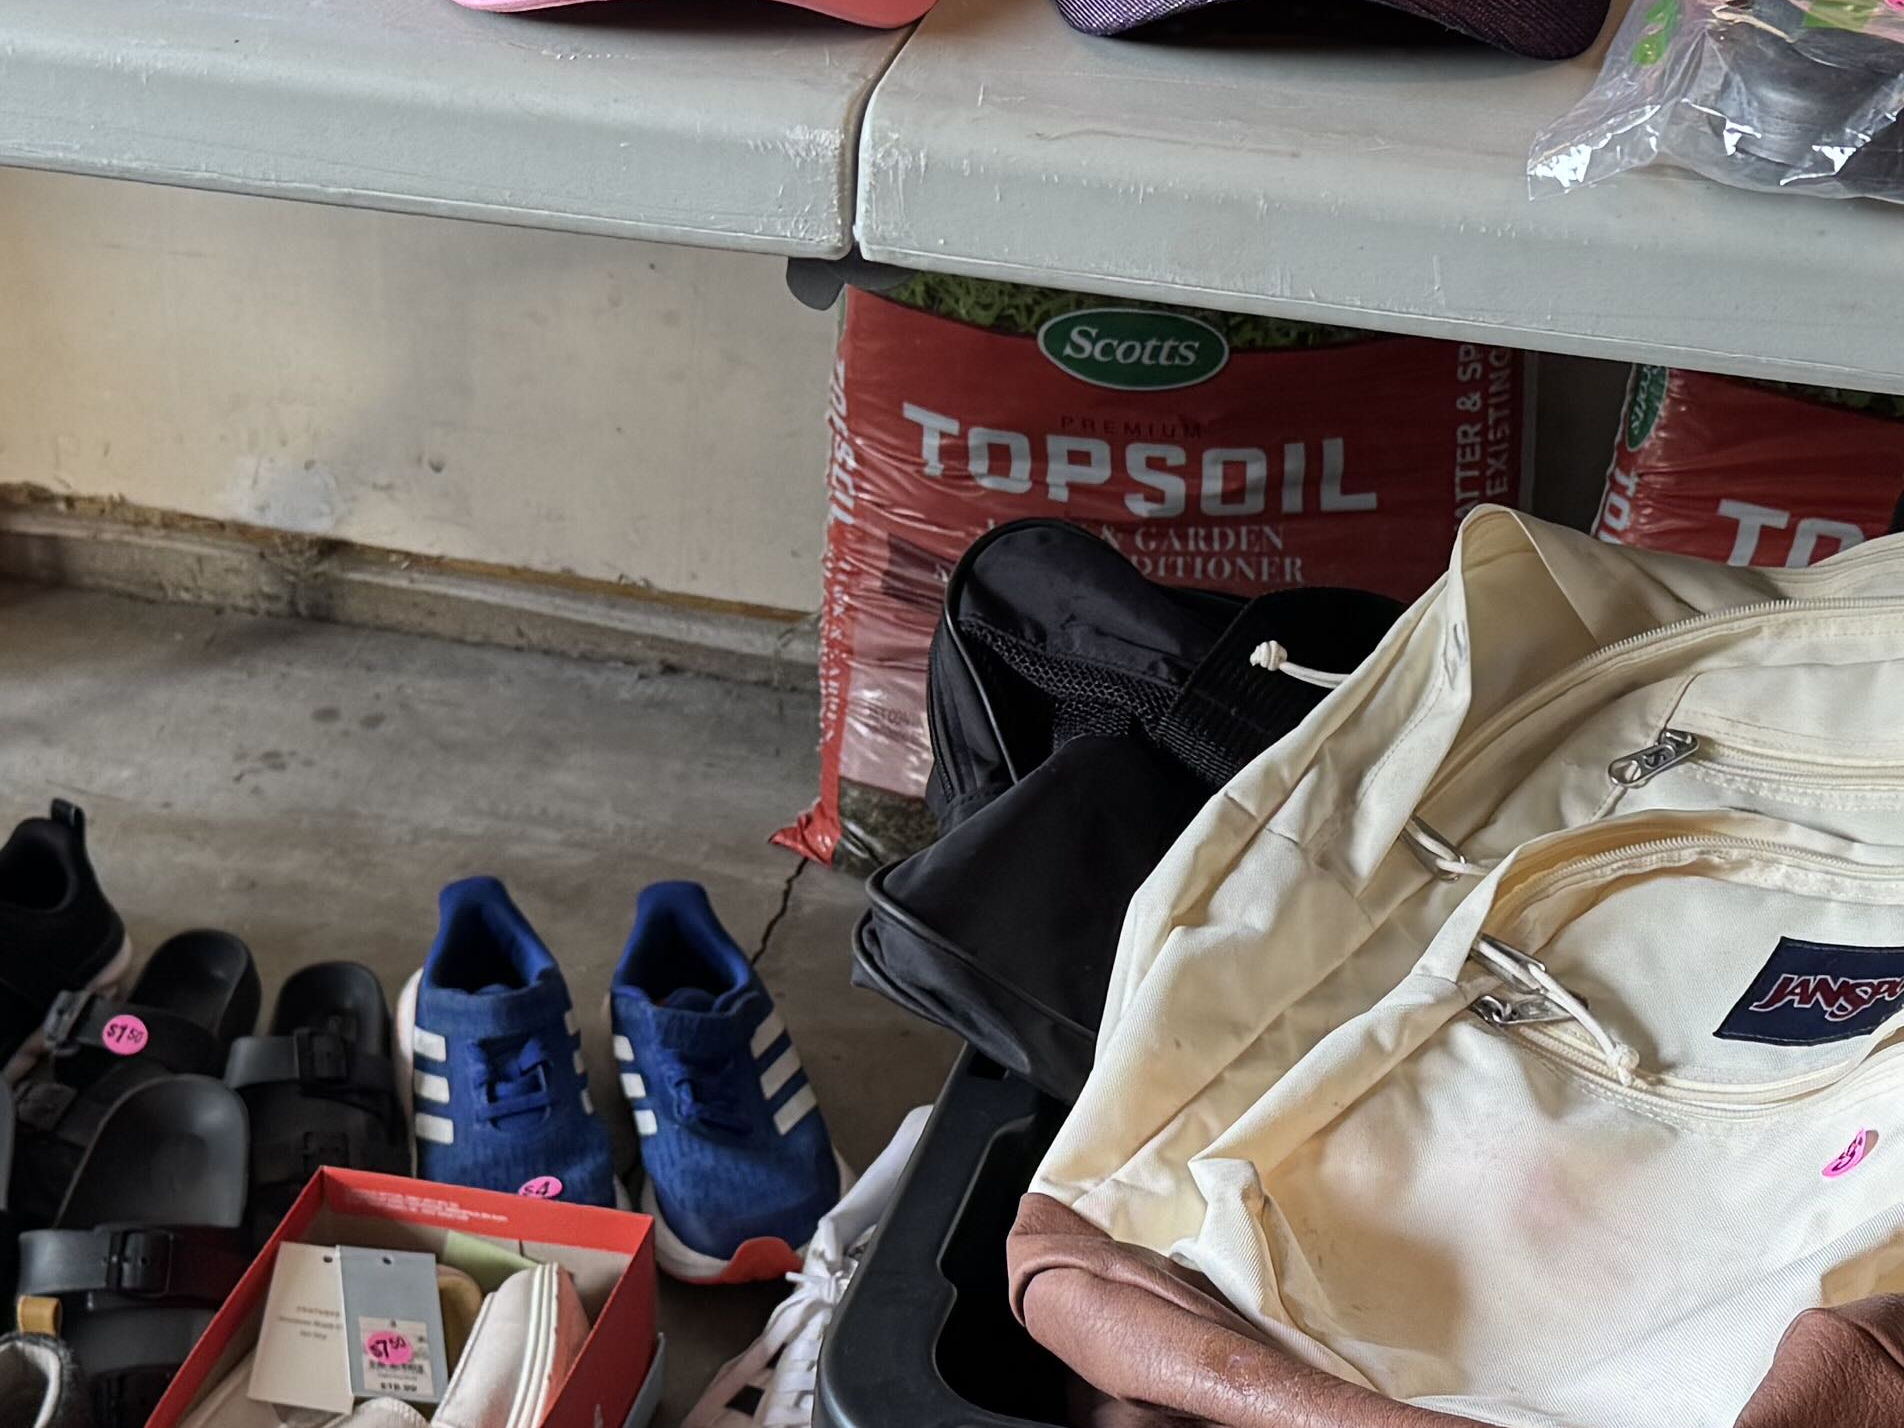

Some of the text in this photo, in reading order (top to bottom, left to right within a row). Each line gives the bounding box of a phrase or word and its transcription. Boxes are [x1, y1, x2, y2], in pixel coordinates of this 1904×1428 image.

[1062, 325, 1200, 367] Scotts
[901, 401, 1378, 520] TOPSOIL
[1134, 523, 1286, 553] GARDEN
